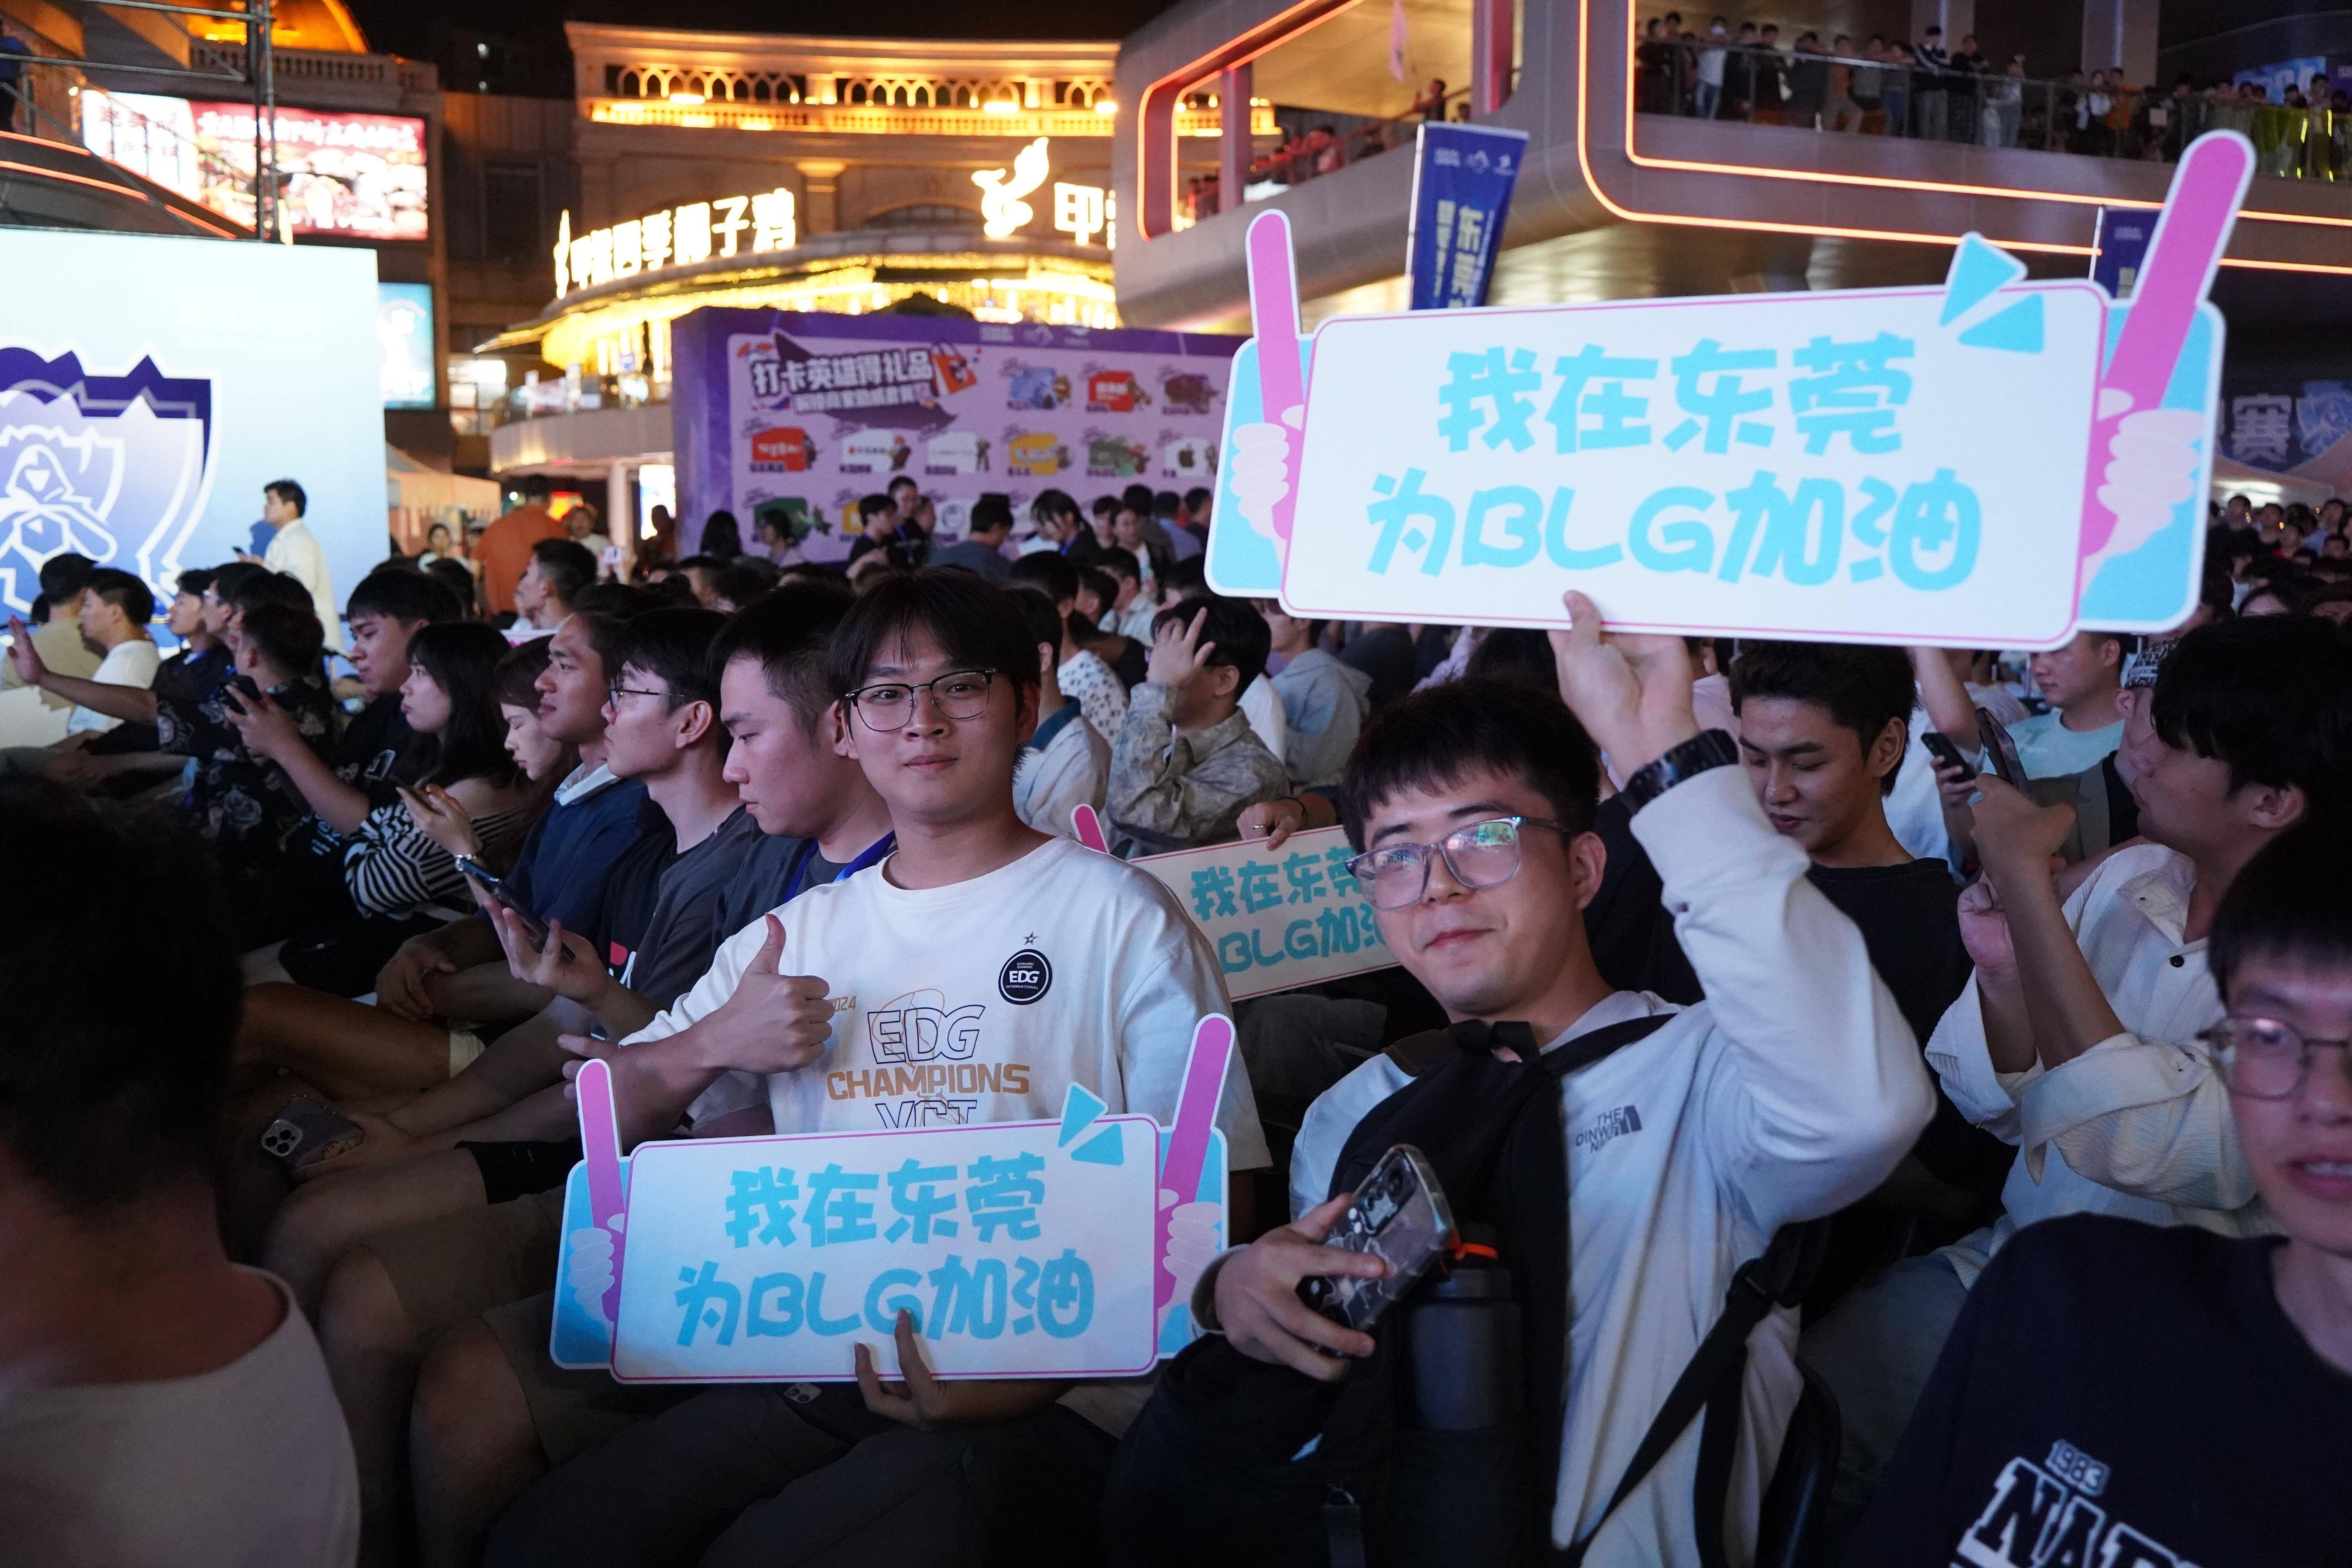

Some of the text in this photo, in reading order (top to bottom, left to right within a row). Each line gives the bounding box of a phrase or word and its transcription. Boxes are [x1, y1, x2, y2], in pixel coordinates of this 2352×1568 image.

[753, 350, 933, 395] 打卡英雄得礼品
[1437, 331, 1916, 456] 我在东莞
[2215, 393, 2292, 465] 赛
[1367, 467, 1982, 591] 为BLG加油
[828, 996, 857, 1012] 024
[1009, 970, 1040, 983] EDG
[867, 1004, 986, 1064] EDG
[827, 1062, 1031, 1101] CHAMPIONS
[1597, 1107, 1622, 1125] THE
[725, 1151, 1045, 1248] 我在东莞
[675, 1249, 1094, 1347] 为BLG加油
[2045, 1441, 2108, 1495] 1983
